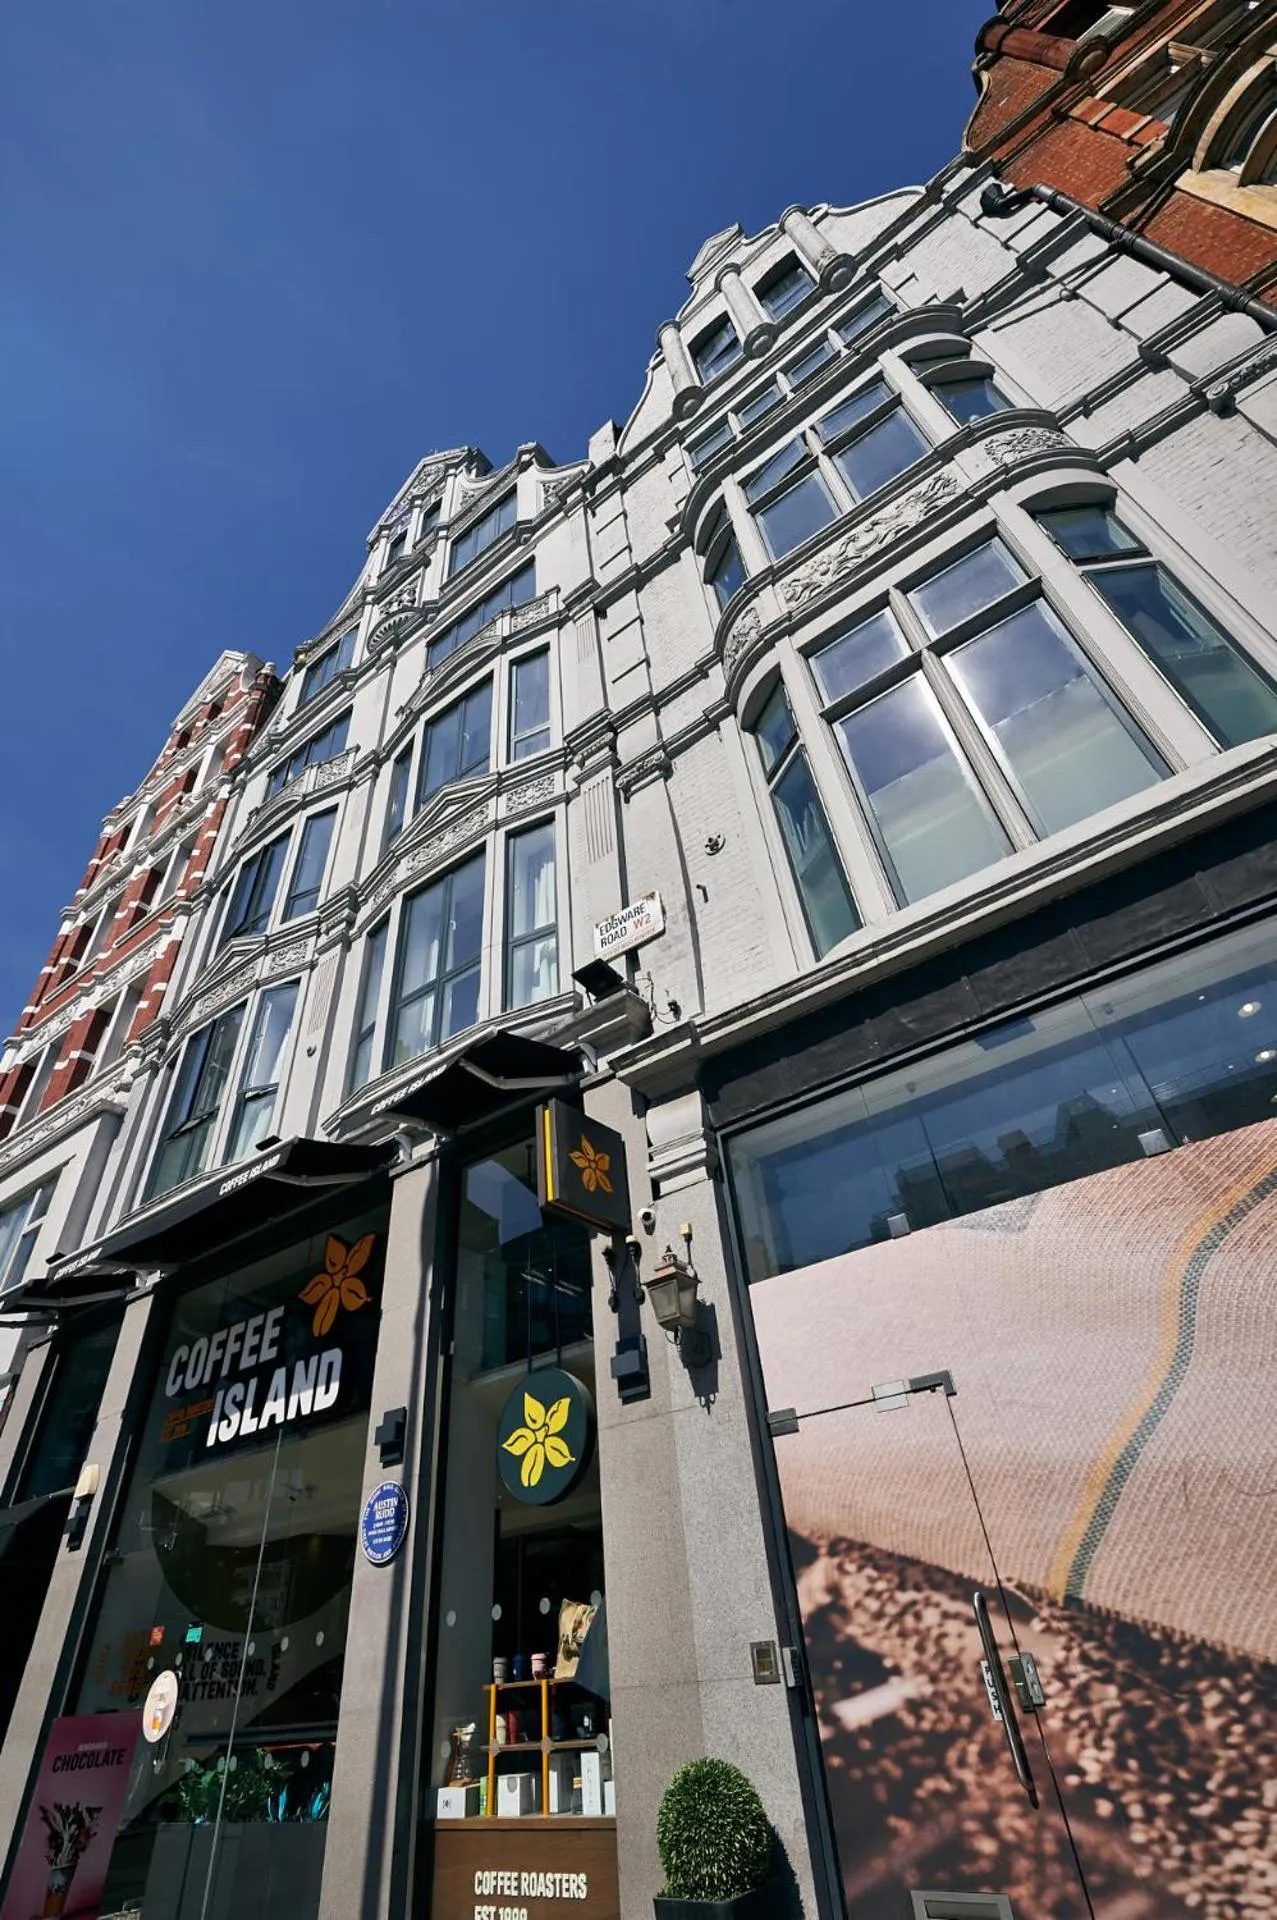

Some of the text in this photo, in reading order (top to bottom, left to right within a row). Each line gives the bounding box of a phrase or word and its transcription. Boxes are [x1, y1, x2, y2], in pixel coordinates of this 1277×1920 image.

[600, 902, 646, 936] EDGWARE
[600, 926, 628, 948] ROAD
[633, 913, 651, 930] W2
[165, 1304, 285, 1397] COFFEE
[206, 1347, 343, 1447] ISLAND
[374, 1496, 399, 1511] AUSTIN
[52, 1748, 126, 1773] CHOCOLATE
[474, 1870, 587, 1900] COFFEE ROASTERS
